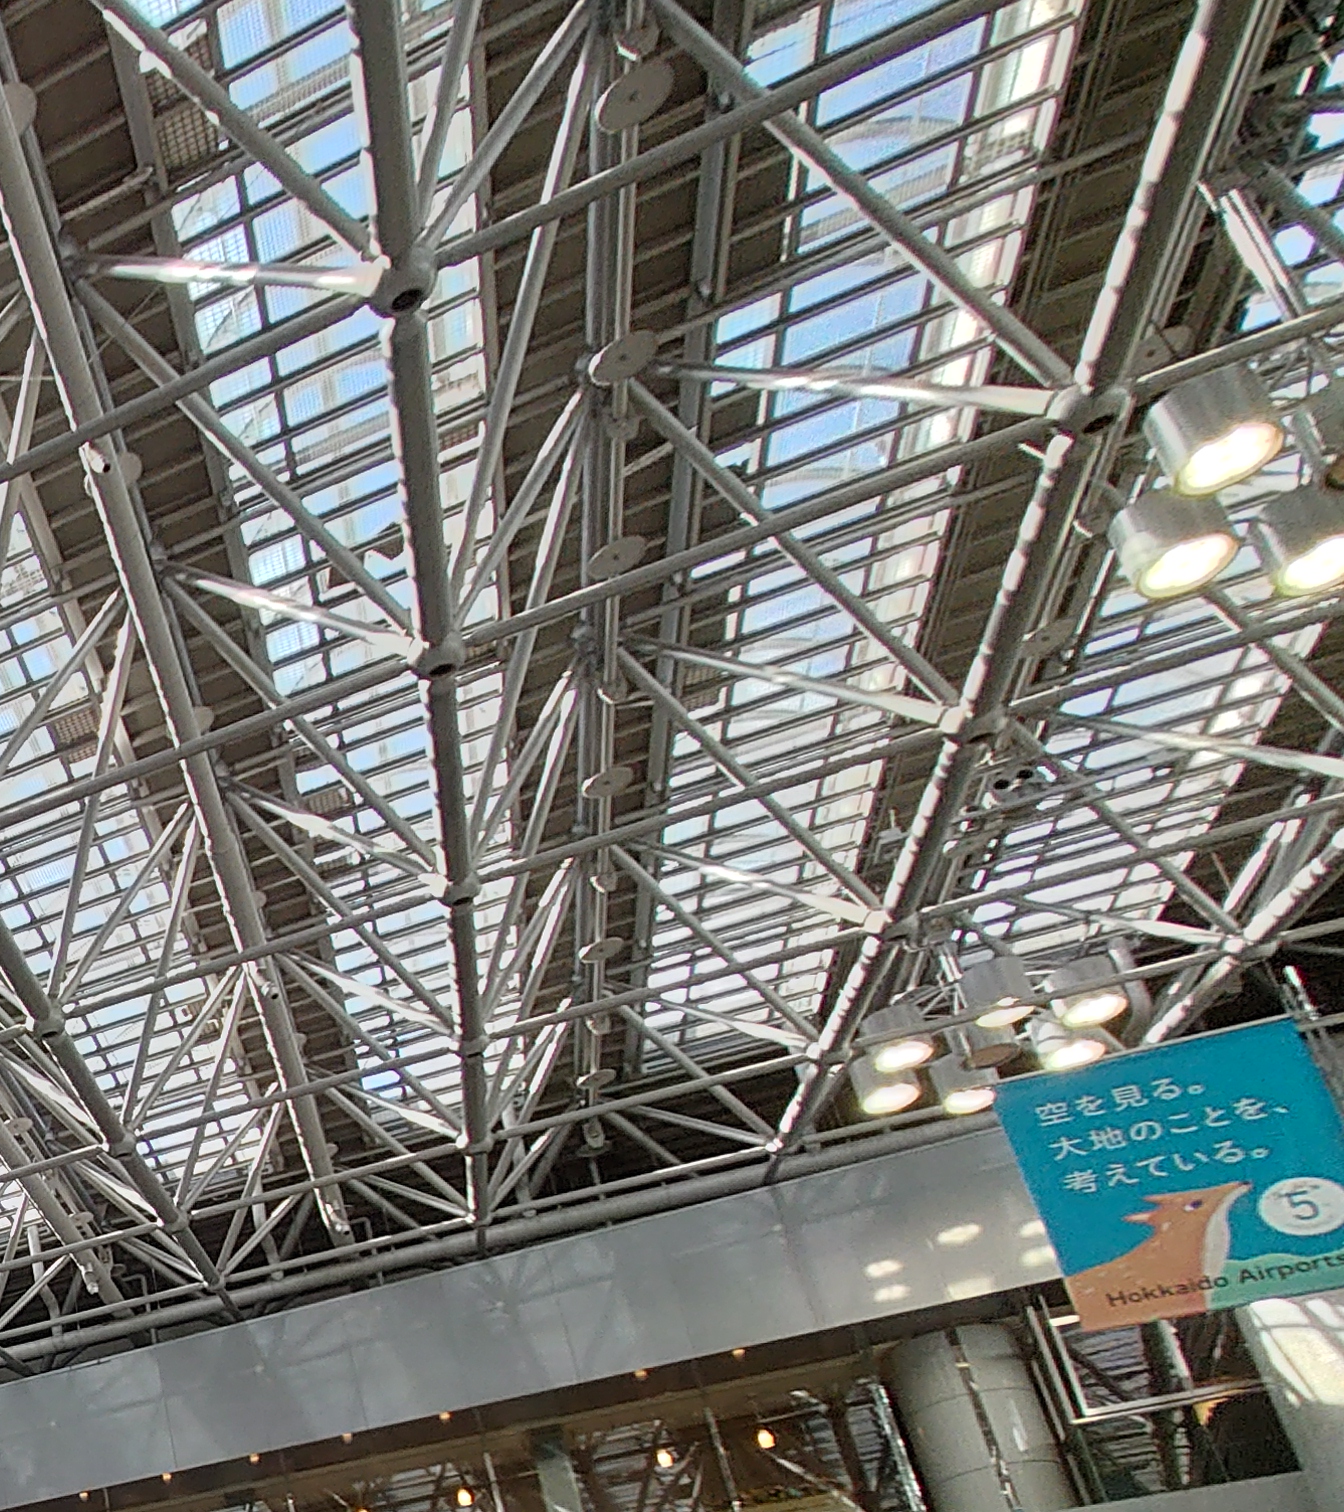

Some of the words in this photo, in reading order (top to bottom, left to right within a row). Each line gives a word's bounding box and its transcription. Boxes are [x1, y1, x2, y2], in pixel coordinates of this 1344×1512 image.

[1035, 1077, 1207, 1127] 空を見る。
[1048, 1097, 1290, 1161] 大地のことを、
[1063, 1140, 1269, 1194] 考えている。
[1278, 1185, 1320, 1221] 5
[1105, 1276, 1228, 1307] Hokkaido
